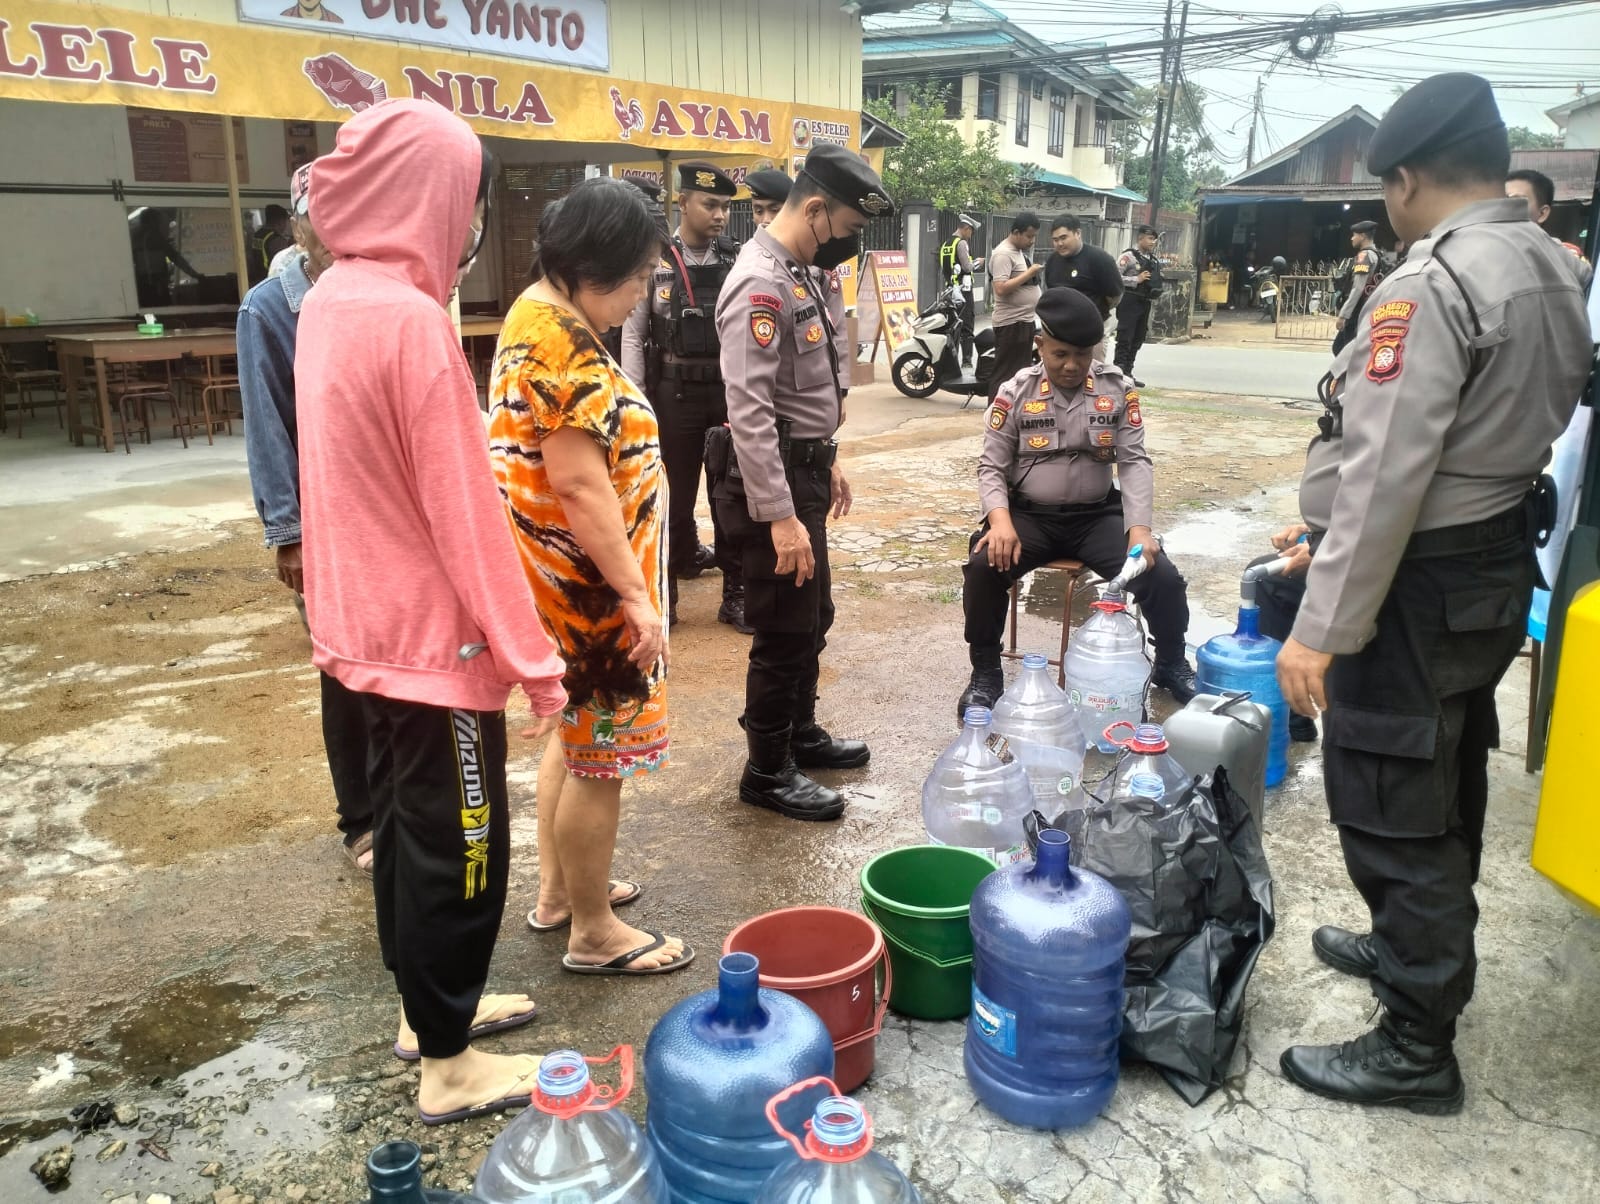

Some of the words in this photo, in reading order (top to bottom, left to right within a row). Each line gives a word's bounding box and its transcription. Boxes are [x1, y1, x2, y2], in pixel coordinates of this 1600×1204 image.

[463, 0, 585, 50] YANTO
[0, 20, 216, 92] LELE
[404, 67, 554, 123] NILA
[650, 99, 772, 144] AYAM
[811, 121, 822, 133] ES
[824, 123, 850, 137] TELER
[453, 709, 484, 808] MIZUNO
[852, 984, 860, 1002] 5
